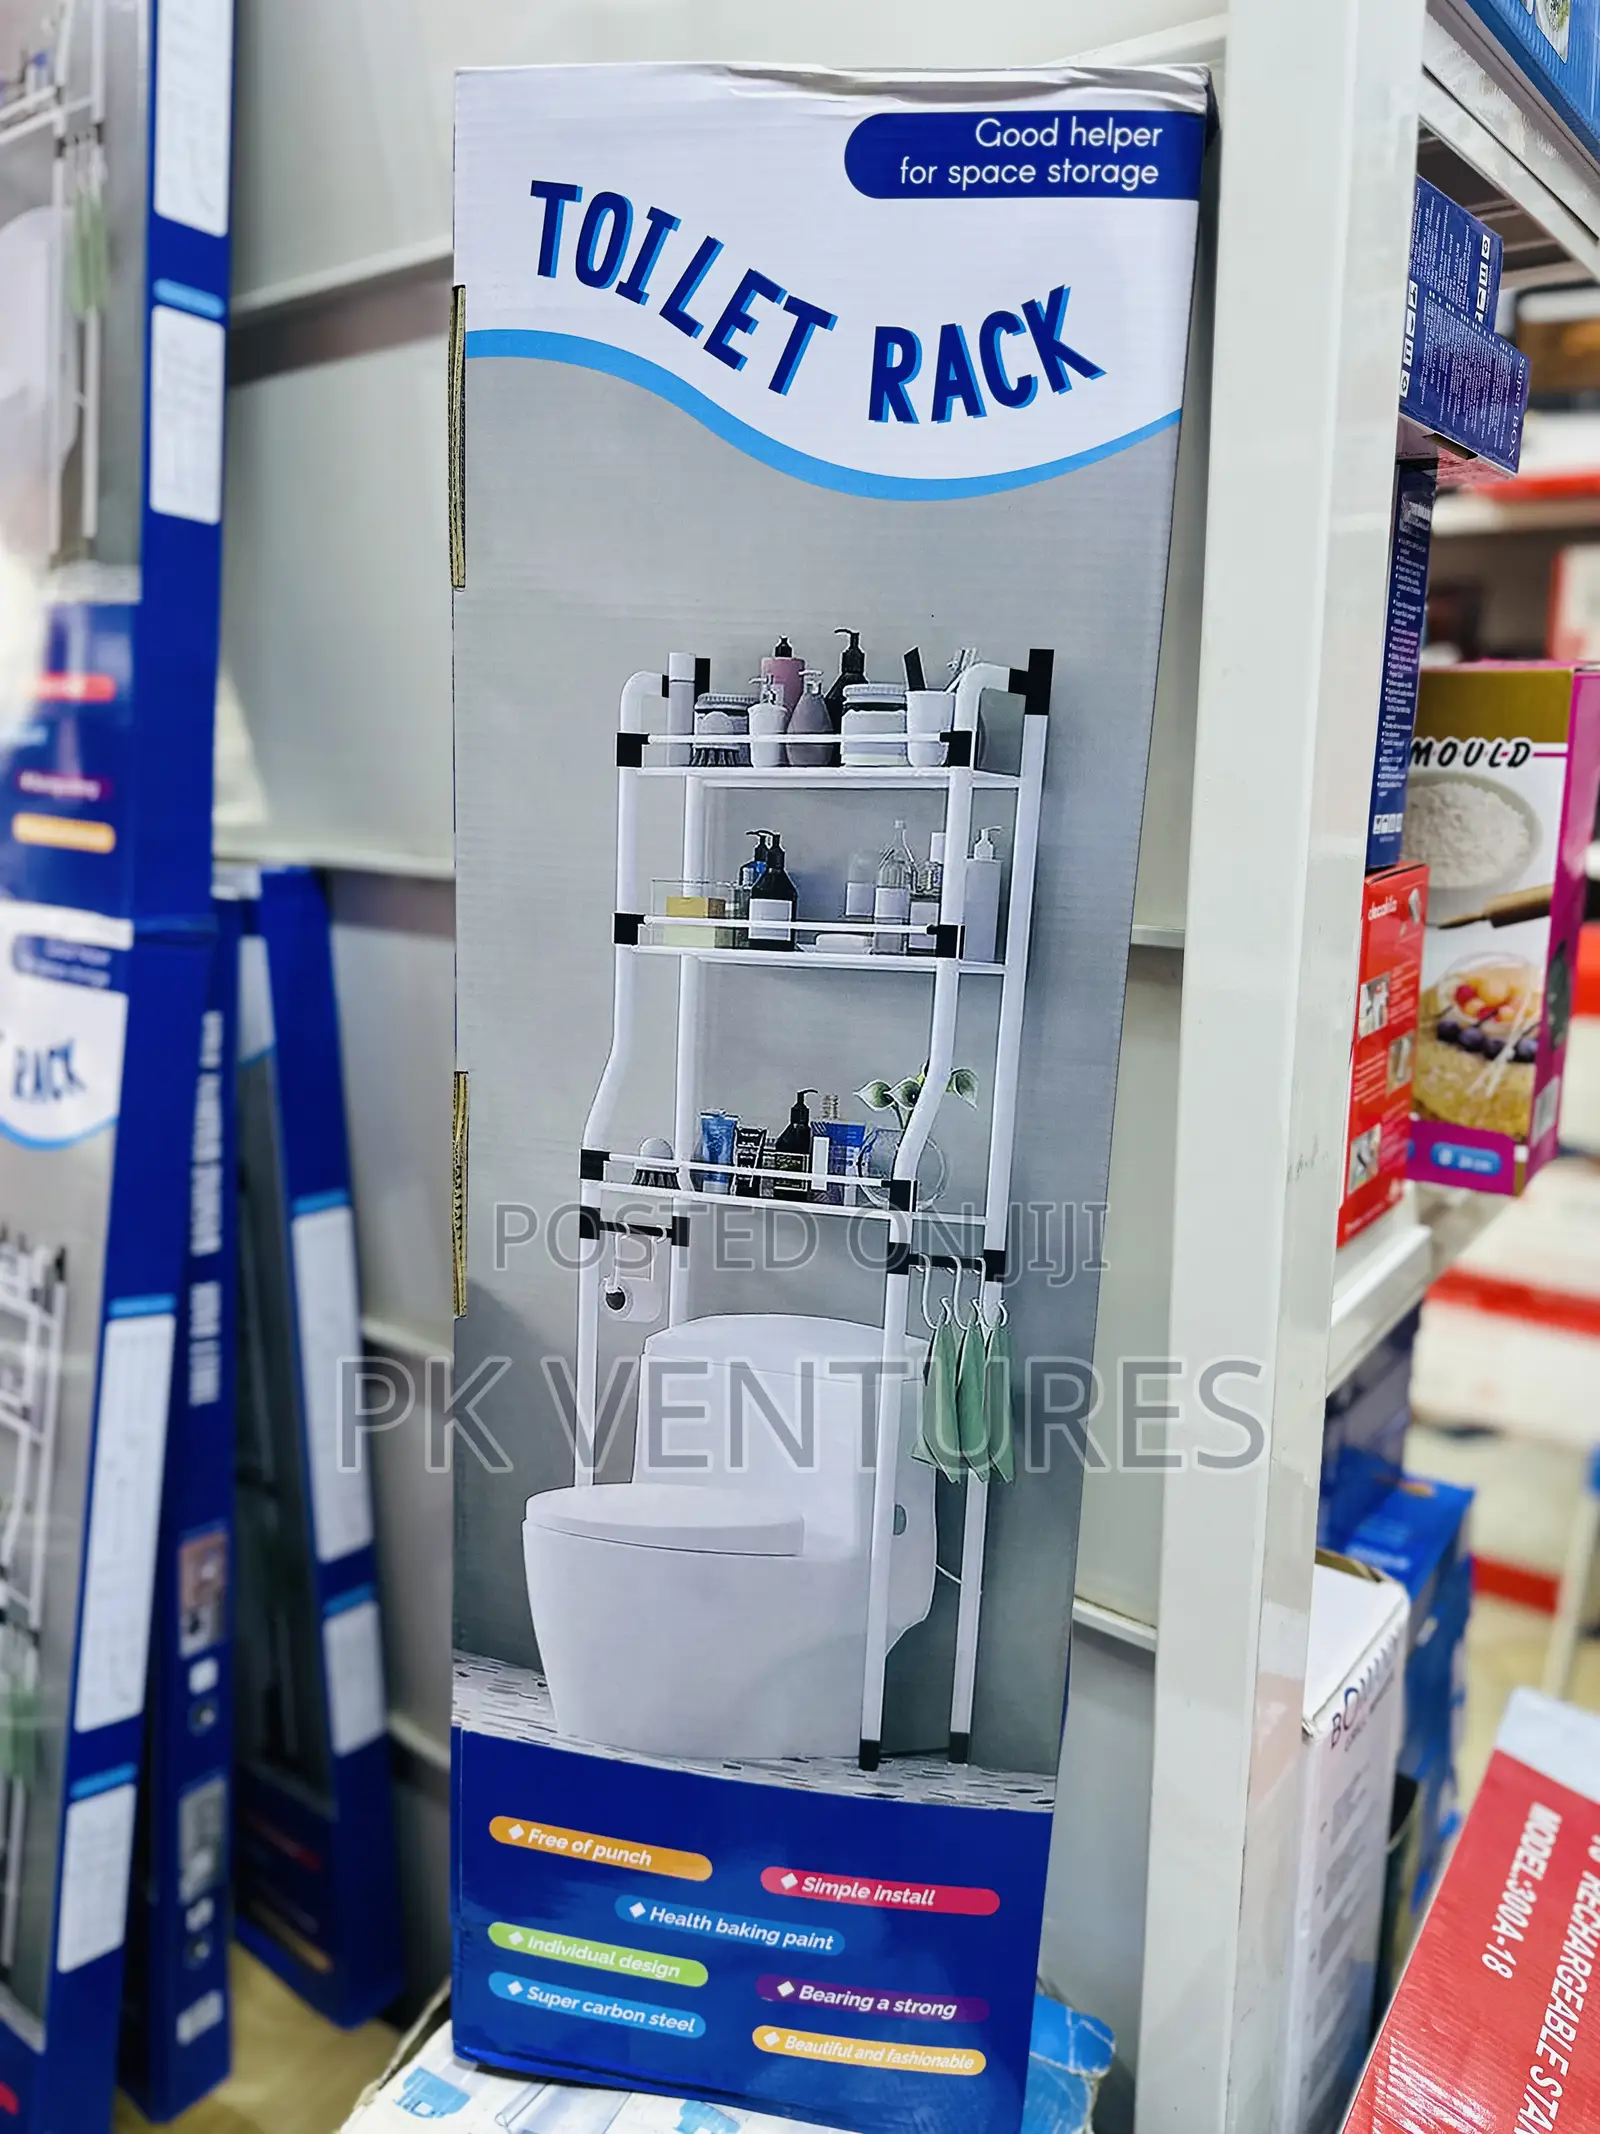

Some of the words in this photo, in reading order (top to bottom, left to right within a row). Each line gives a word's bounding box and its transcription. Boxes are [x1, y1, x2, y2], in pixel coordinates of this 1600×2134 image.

[975, 117, 1059, 147] Good
[1070, 115, 1163, 154] helper
[900, 156, 938, 184] for
[948, 164, 1036, 191] space
[1047, 158, 1159, 191] storage
[530, 180, 838, 396] TOILET
[867, 284, 1107, 424] RACK
[1514, 358, 1526, 410] Super
[1508, 415, 1519, 460] BOX
[1410, 740, 1531, 768] MOULD
[527, 1828, 569, 1850] Free
[571, 1839, 593, 1855] of
[591, 1846, 653, 1868] punch
[801, 1876, 871, 1901] Simple
[873, 1884, 936, 1907] install
[1481, 1801, 1562, 1979] MODEL:300A-18
[649, 1905, 713, 1932] Health
[715, 1917, 781, 1946] baking
[782, 1931, 835, 1951] paint
[527, 1935, 616, 1967] Individual
[618, 1951, 681, 1980] design
[1535, 1869, 1600, 2077] RECHARGEABLE
[526, 1985, 580, 2010] Super
[582, 1998, 646, 2024] carbon
[648, 2013, 696, 2034] steel
[799, 1984, 874, 2012] Bearing
[876, 1997, 890, 2011] a
[892, 1999, 958, 2021] strong
[783, 2034, 853, 2059] Beautiful
[854, 2046, 884, 2062] and
[886, 2050, 975, 2070] fashionable
